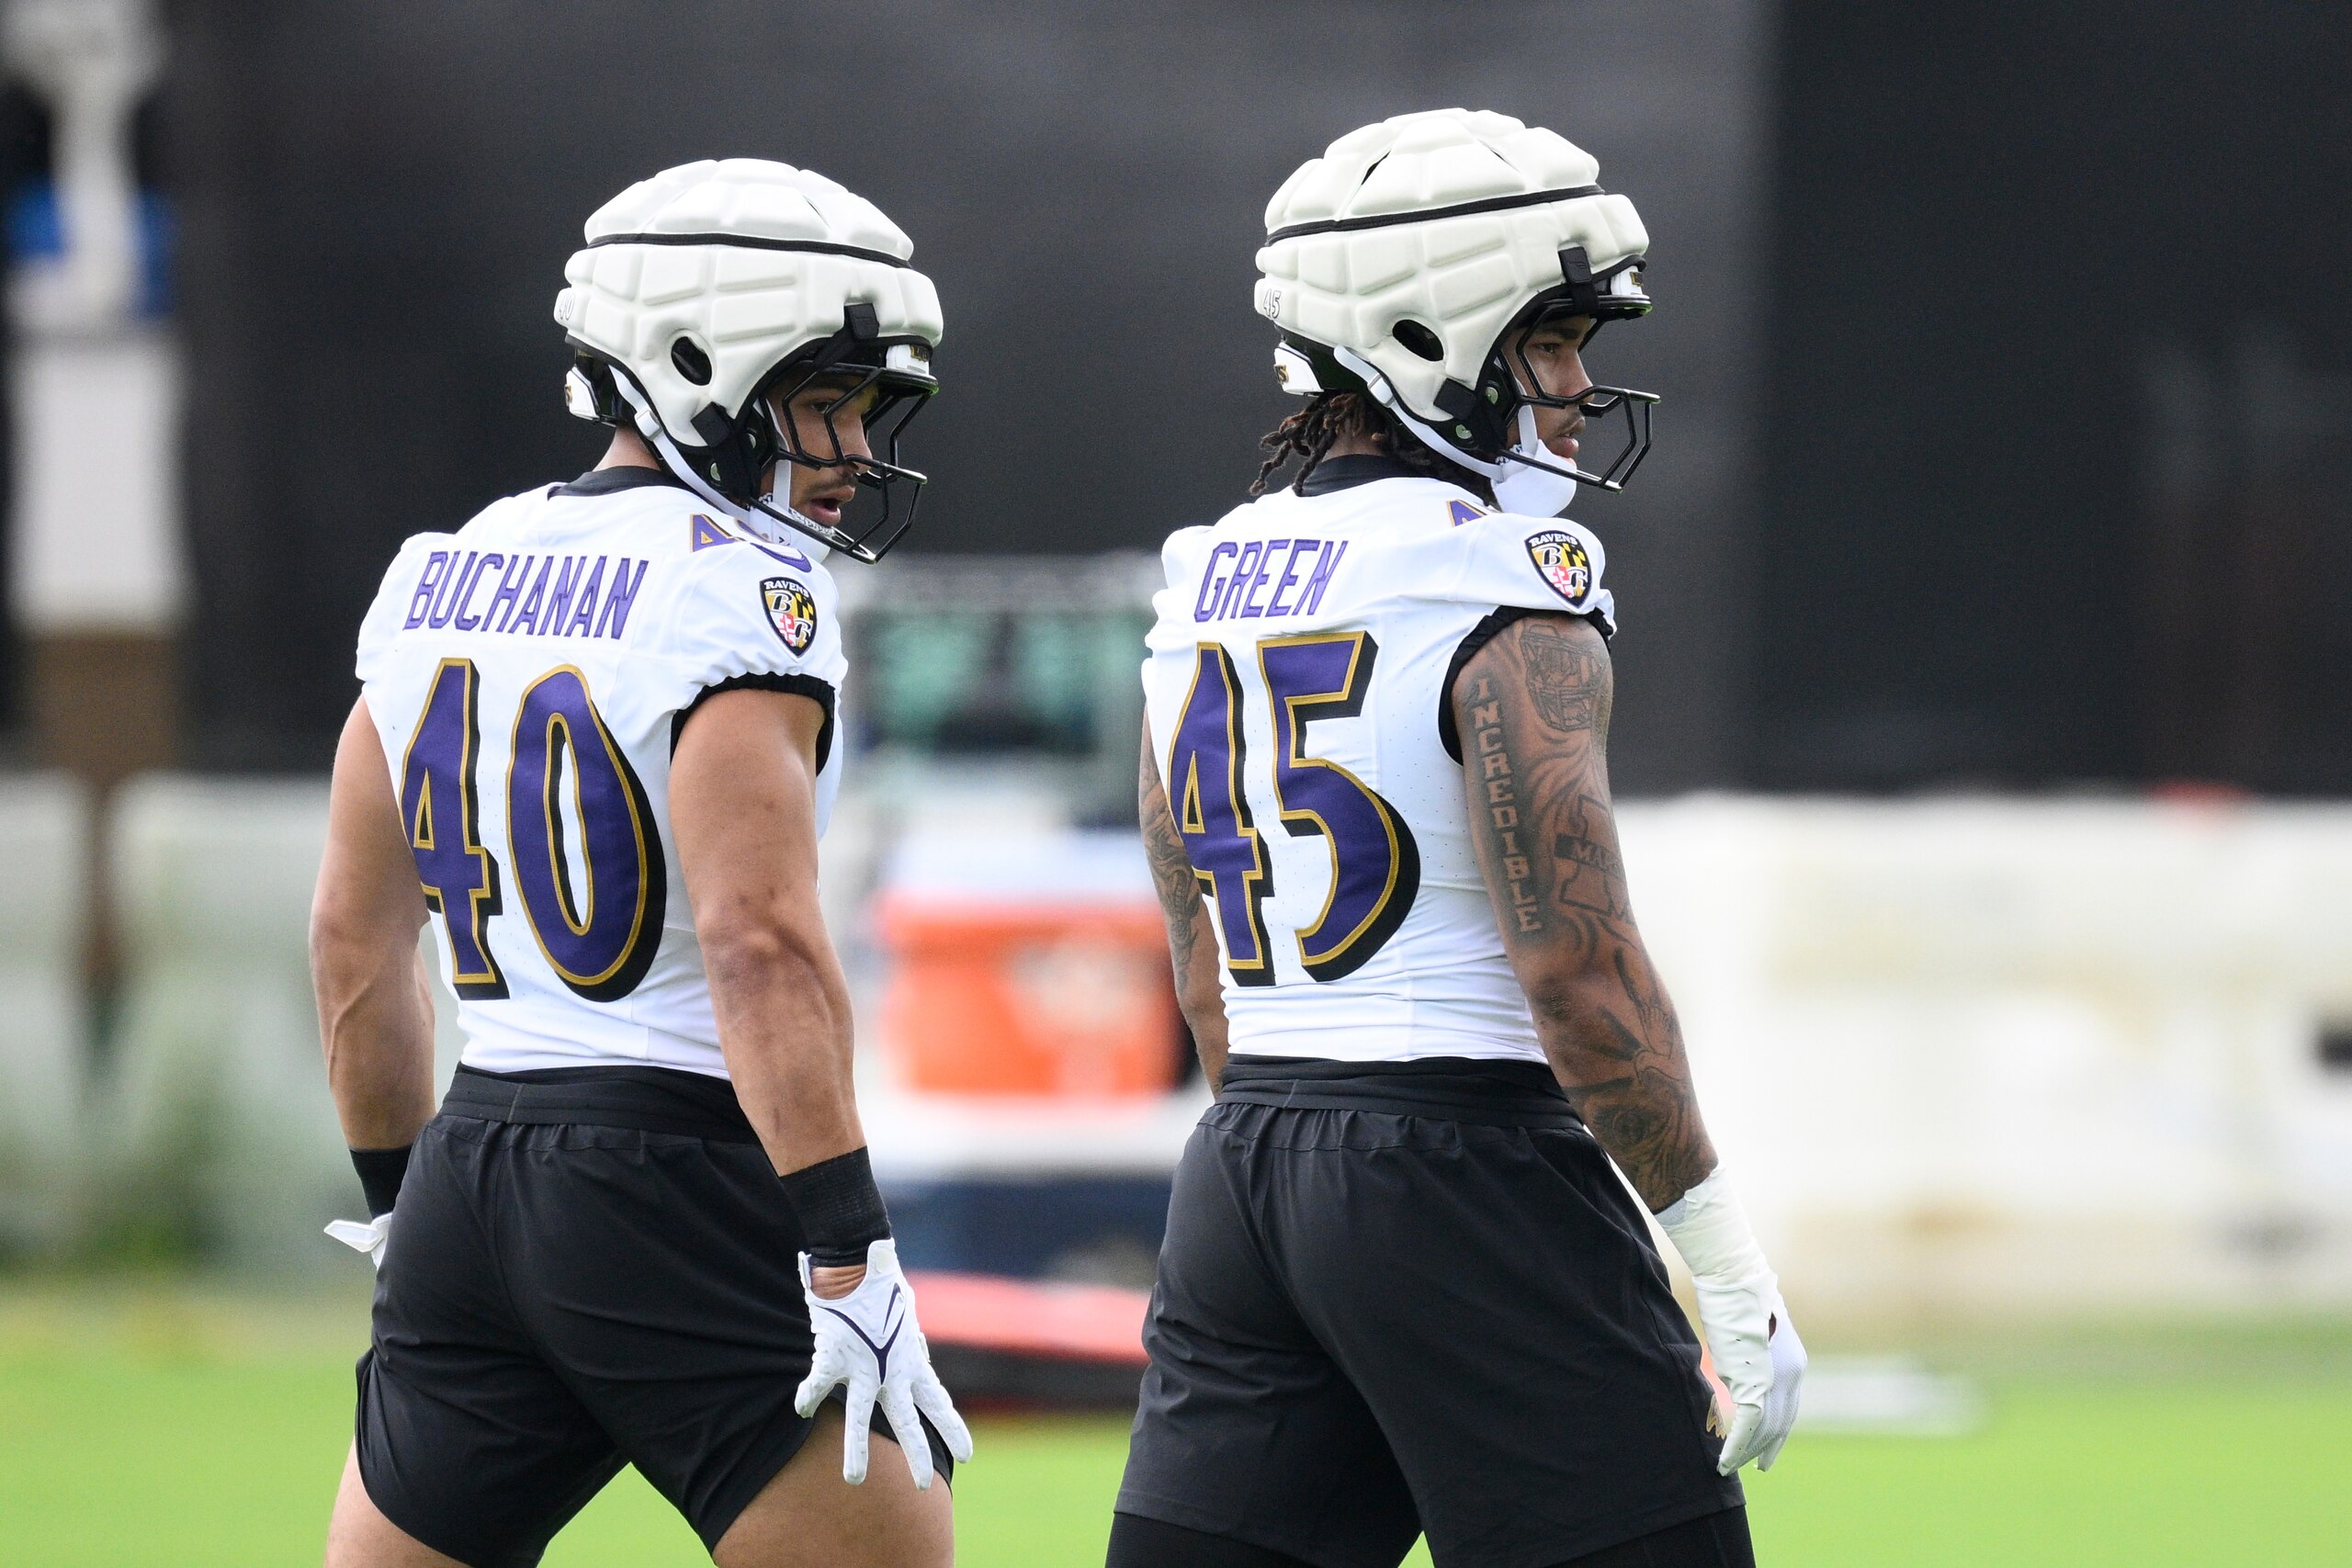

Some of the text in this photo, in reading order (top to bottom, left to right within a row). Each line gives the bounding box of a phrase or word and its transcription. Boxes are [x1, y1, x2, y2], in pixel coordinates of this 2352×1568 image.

[1262, 288, 1282, 320] 45
[1193, 538, 1349, 623] GREEN
[1528, 532, 1578, 548] RAVENS
[401, 549, 650, 640] BUCHANAN
[763, 580, 810, 599] RAVENS
[399, 657, 667, 1003] 40
[1167, 630, 1420, 987] 45
[1472, 677, 1543, 933] INCREDIBLE
